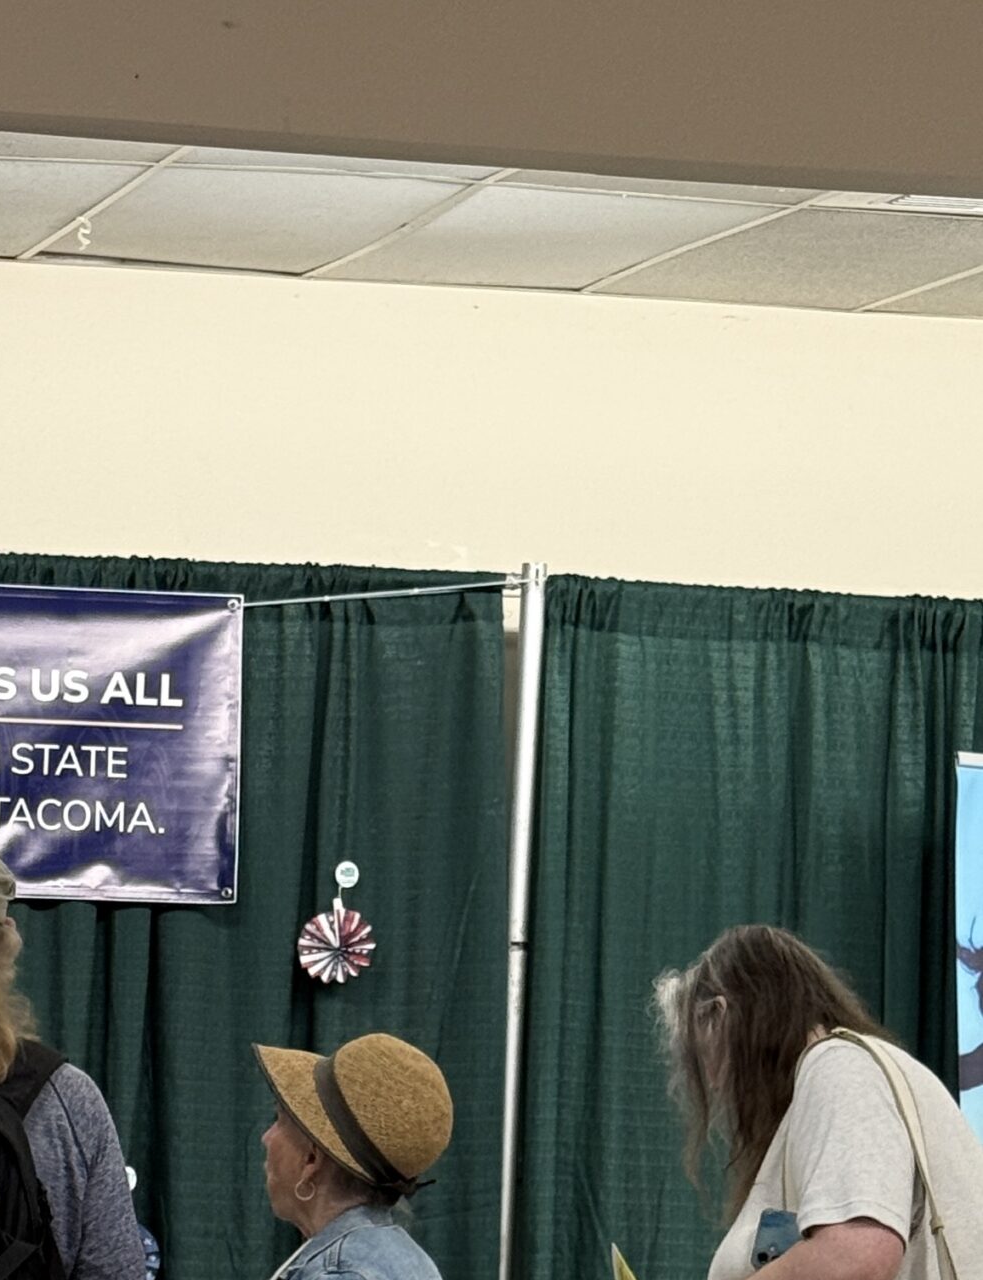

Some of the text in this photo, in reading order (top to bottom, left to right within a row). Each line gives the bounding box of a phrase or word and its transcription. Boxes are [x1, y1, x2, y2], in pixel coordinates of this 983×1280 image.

[31, 668, 89, 703] US
[101, 672, 183, 707] ALL
[10, 742, 128, 778] STATE
